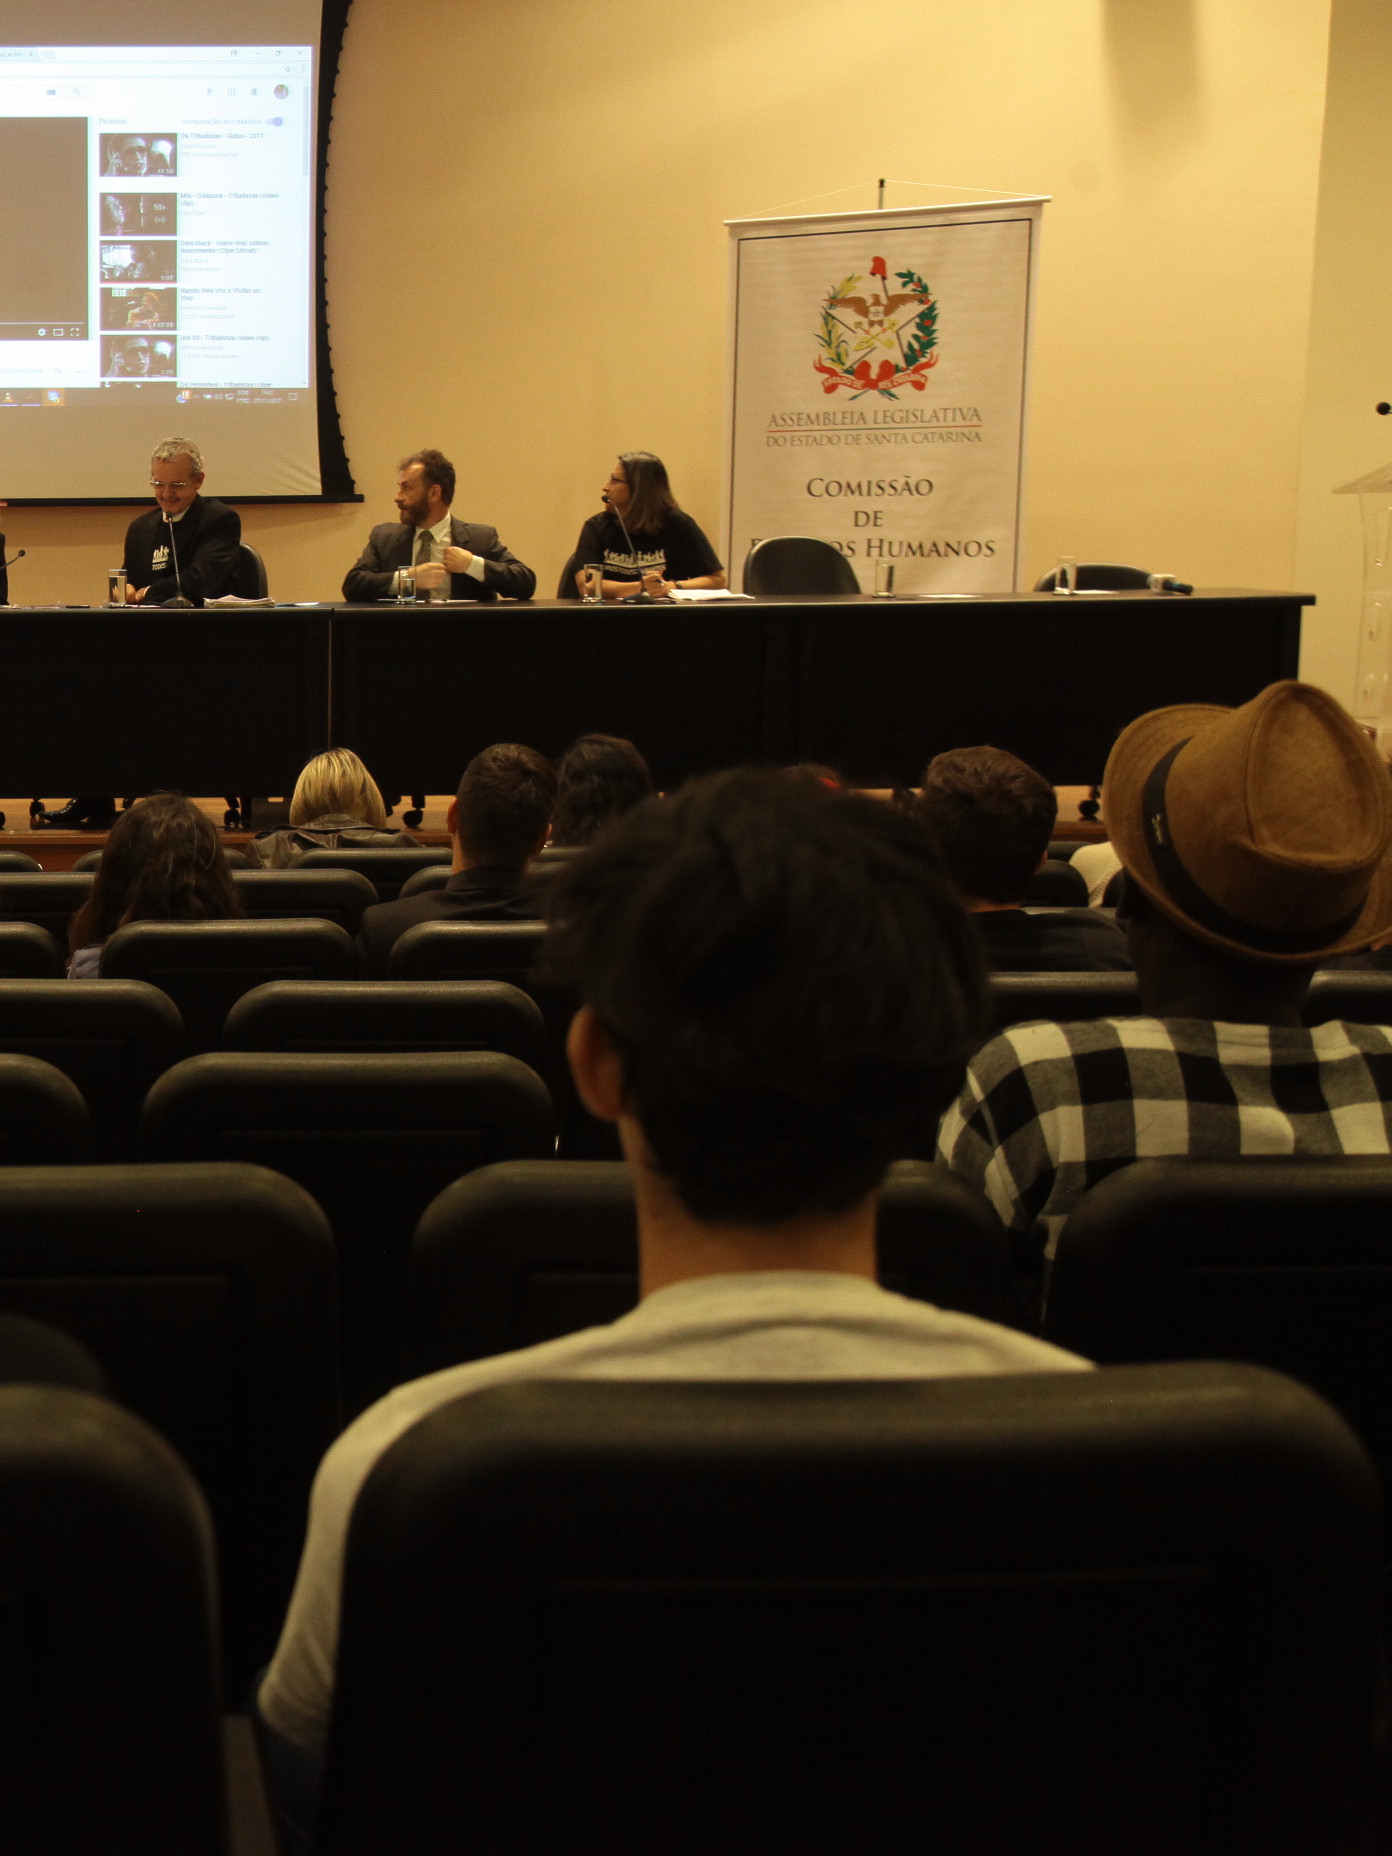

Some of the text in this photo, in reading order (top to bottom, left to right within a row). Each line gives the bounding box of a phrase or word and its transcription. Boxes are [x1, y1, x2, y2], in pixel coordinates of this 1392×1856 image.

[767, 406, 982, 428] ASSEMBLEIA LEGISLATIVA
[766, 430, 982, 448] DO ESTADO DE SANTA CATARINA
[853, 510, 884, 528] DE
[865, 538, 996, 558] HUMANOS
